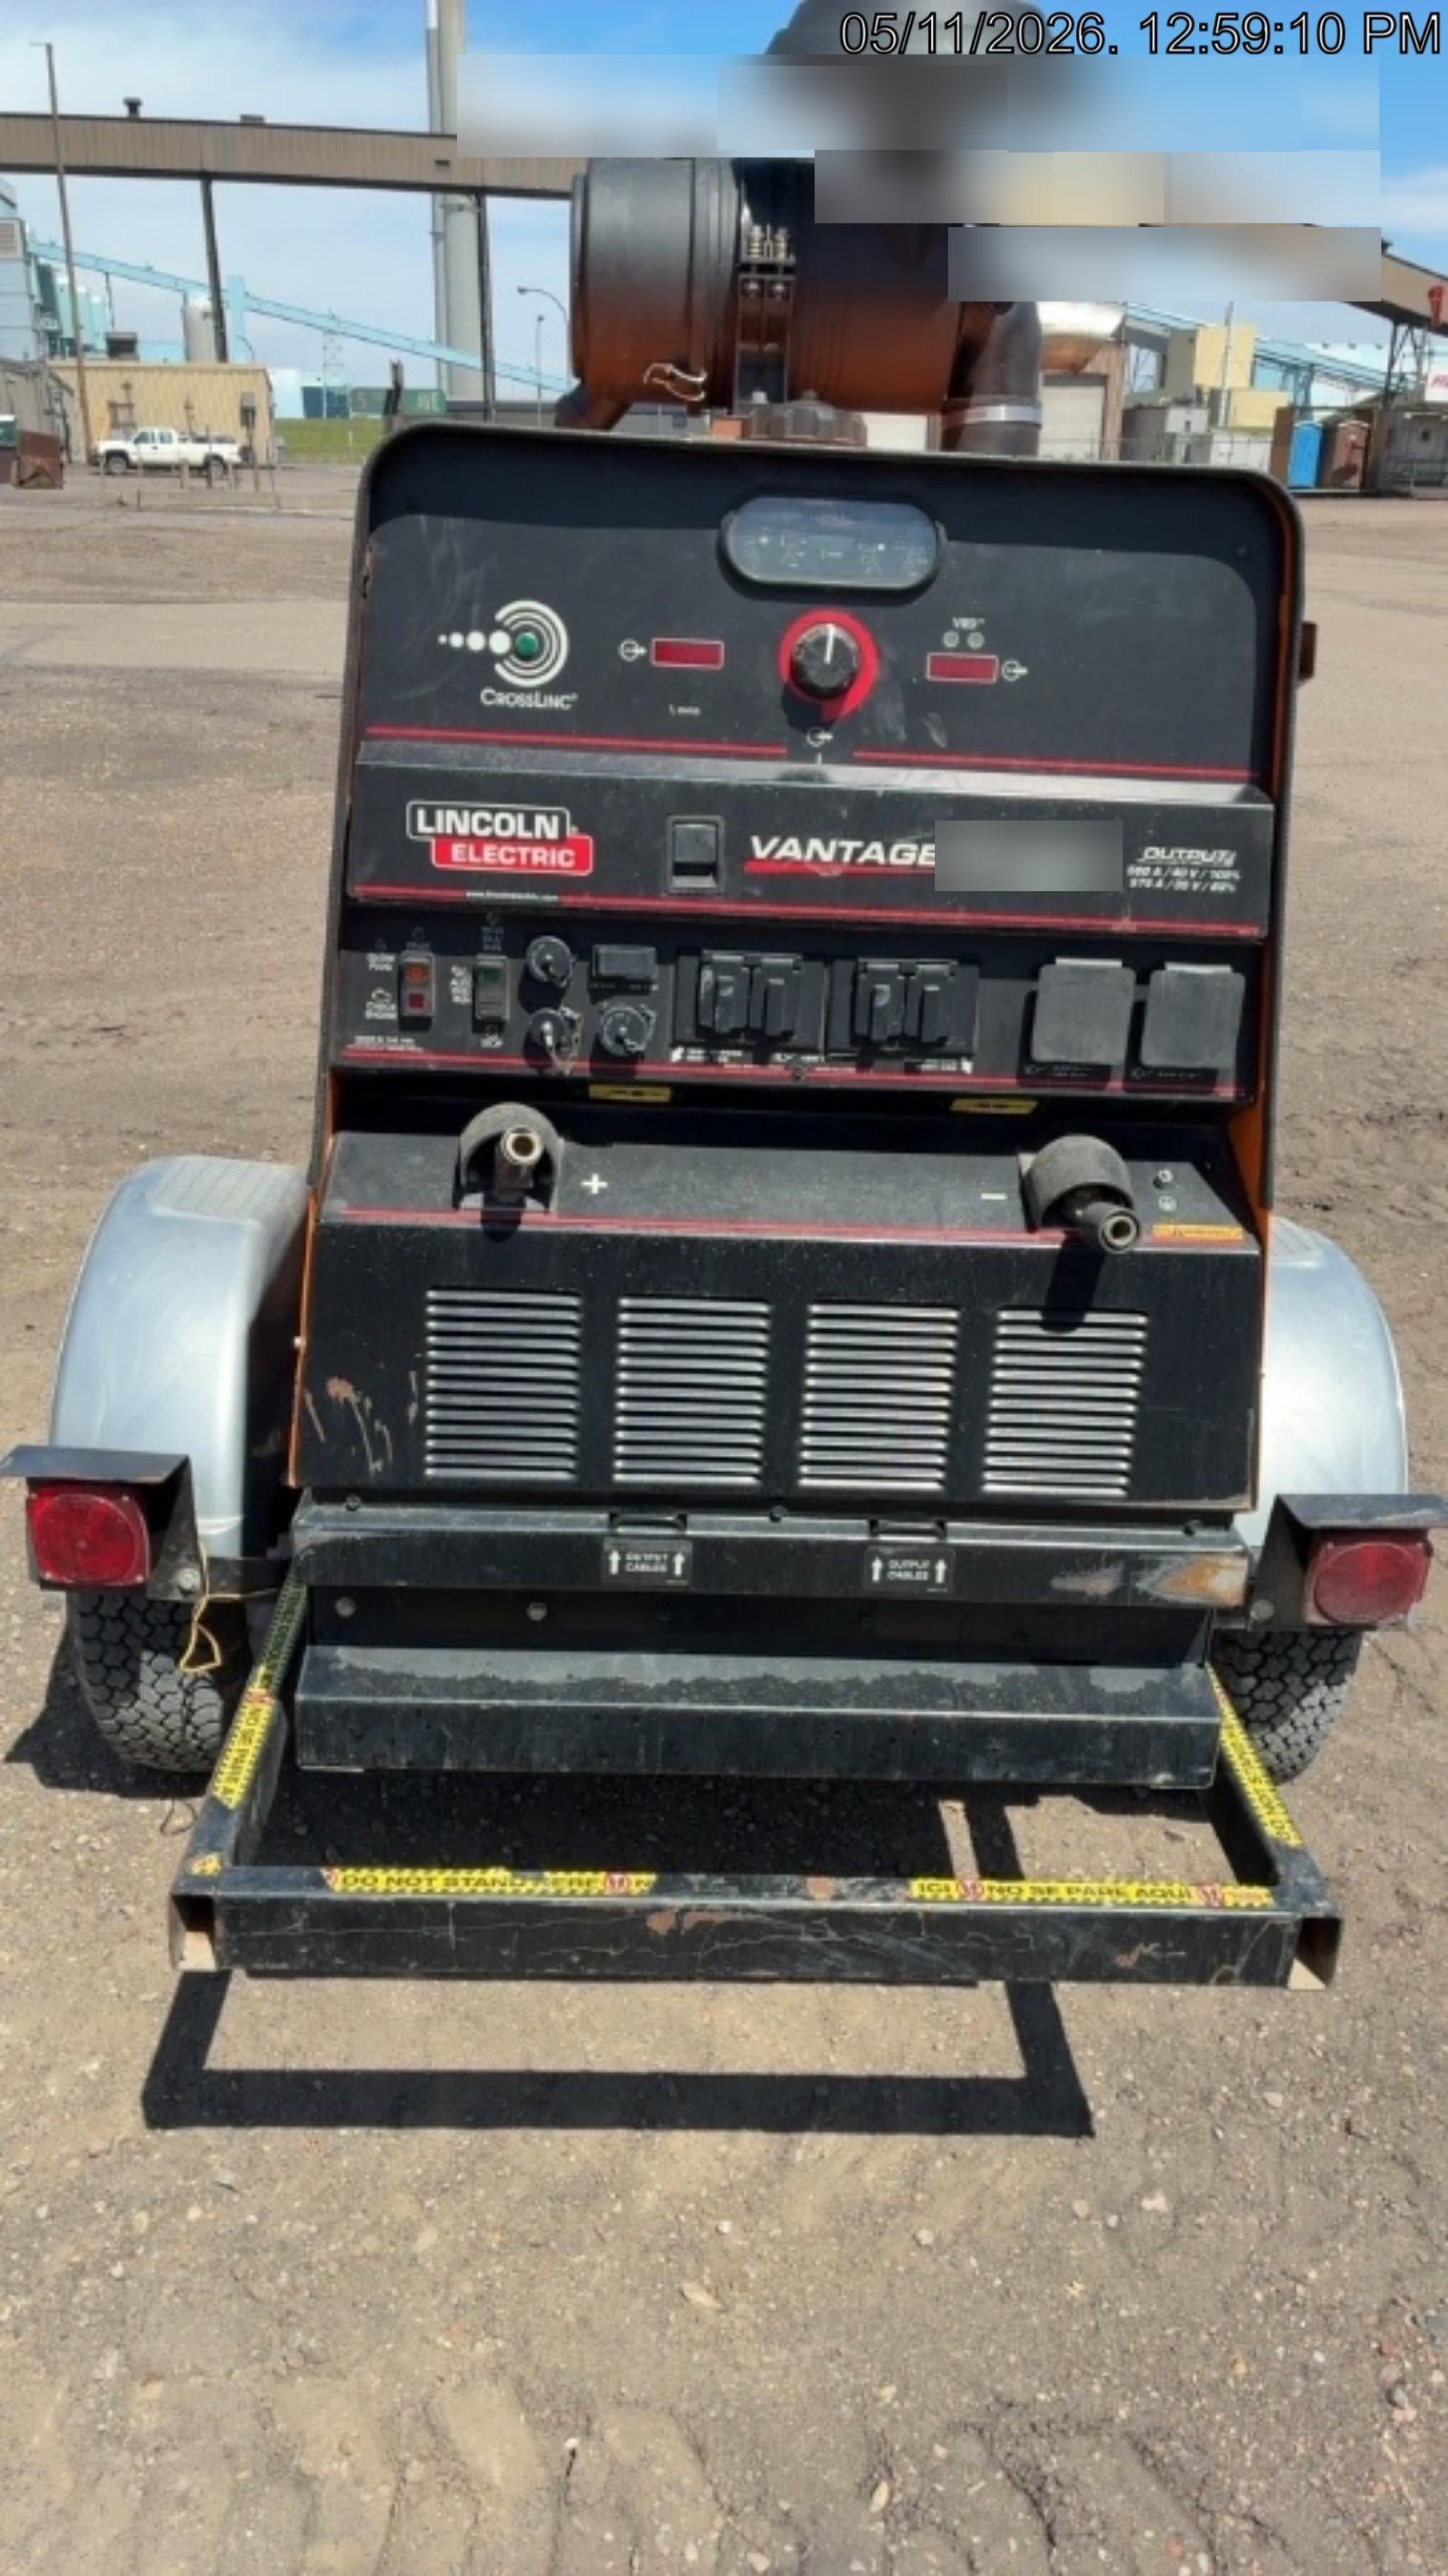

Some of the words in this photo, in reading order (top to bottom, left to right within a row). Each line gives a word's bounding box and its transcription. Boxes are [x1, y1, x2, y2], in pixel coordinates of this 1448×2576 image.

[417, 808, 559, 840] LINCOLN
[451, 843, 575, 867] ELECTRIC
[751, 835, 935, 866] VANTAGE
[1144, 846, 1231, 863] OUTPUT
[626, 1552, 668, 1562] OUTPUT
[626, 1563, 668, 1572] CABLES
[888, 1559, 931, 1569] OUTPUT
[343, 1877, 379, 1887] DO
[386, 1877, 436, 1887] NOT
[987, 1885, 1023, 1896] NO
[1030, 1886, 1058, 1897] SE
[1066, 1886, 1127, 1898] PARE
